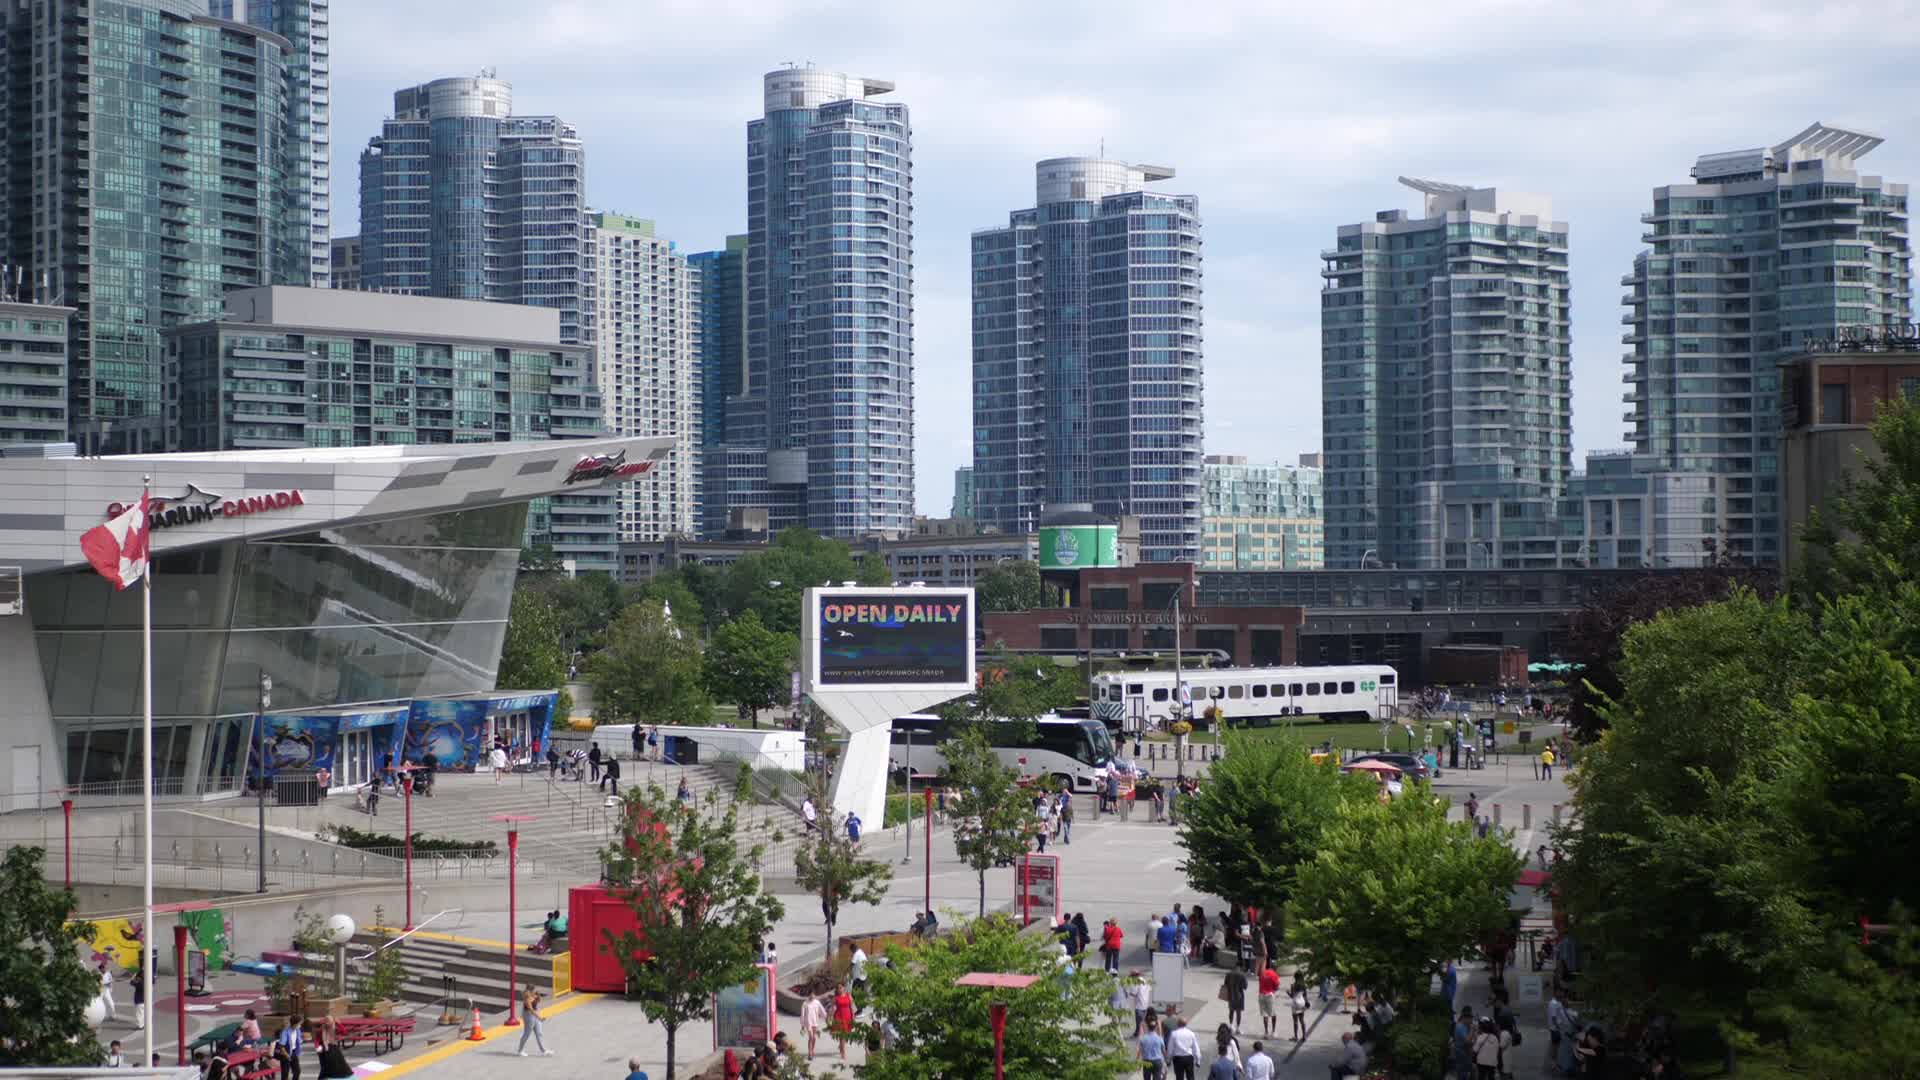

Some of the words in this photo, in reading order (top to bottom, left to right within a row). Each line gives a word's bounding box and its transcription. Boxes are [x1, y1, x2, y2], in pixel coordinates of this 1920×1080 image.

[223, 489, 304, 517] CANADA
[824, 604, 887, 622] OPEN
[894, 604, 961, 622] DAILY
[1360, 681, 1376, 691] GO
